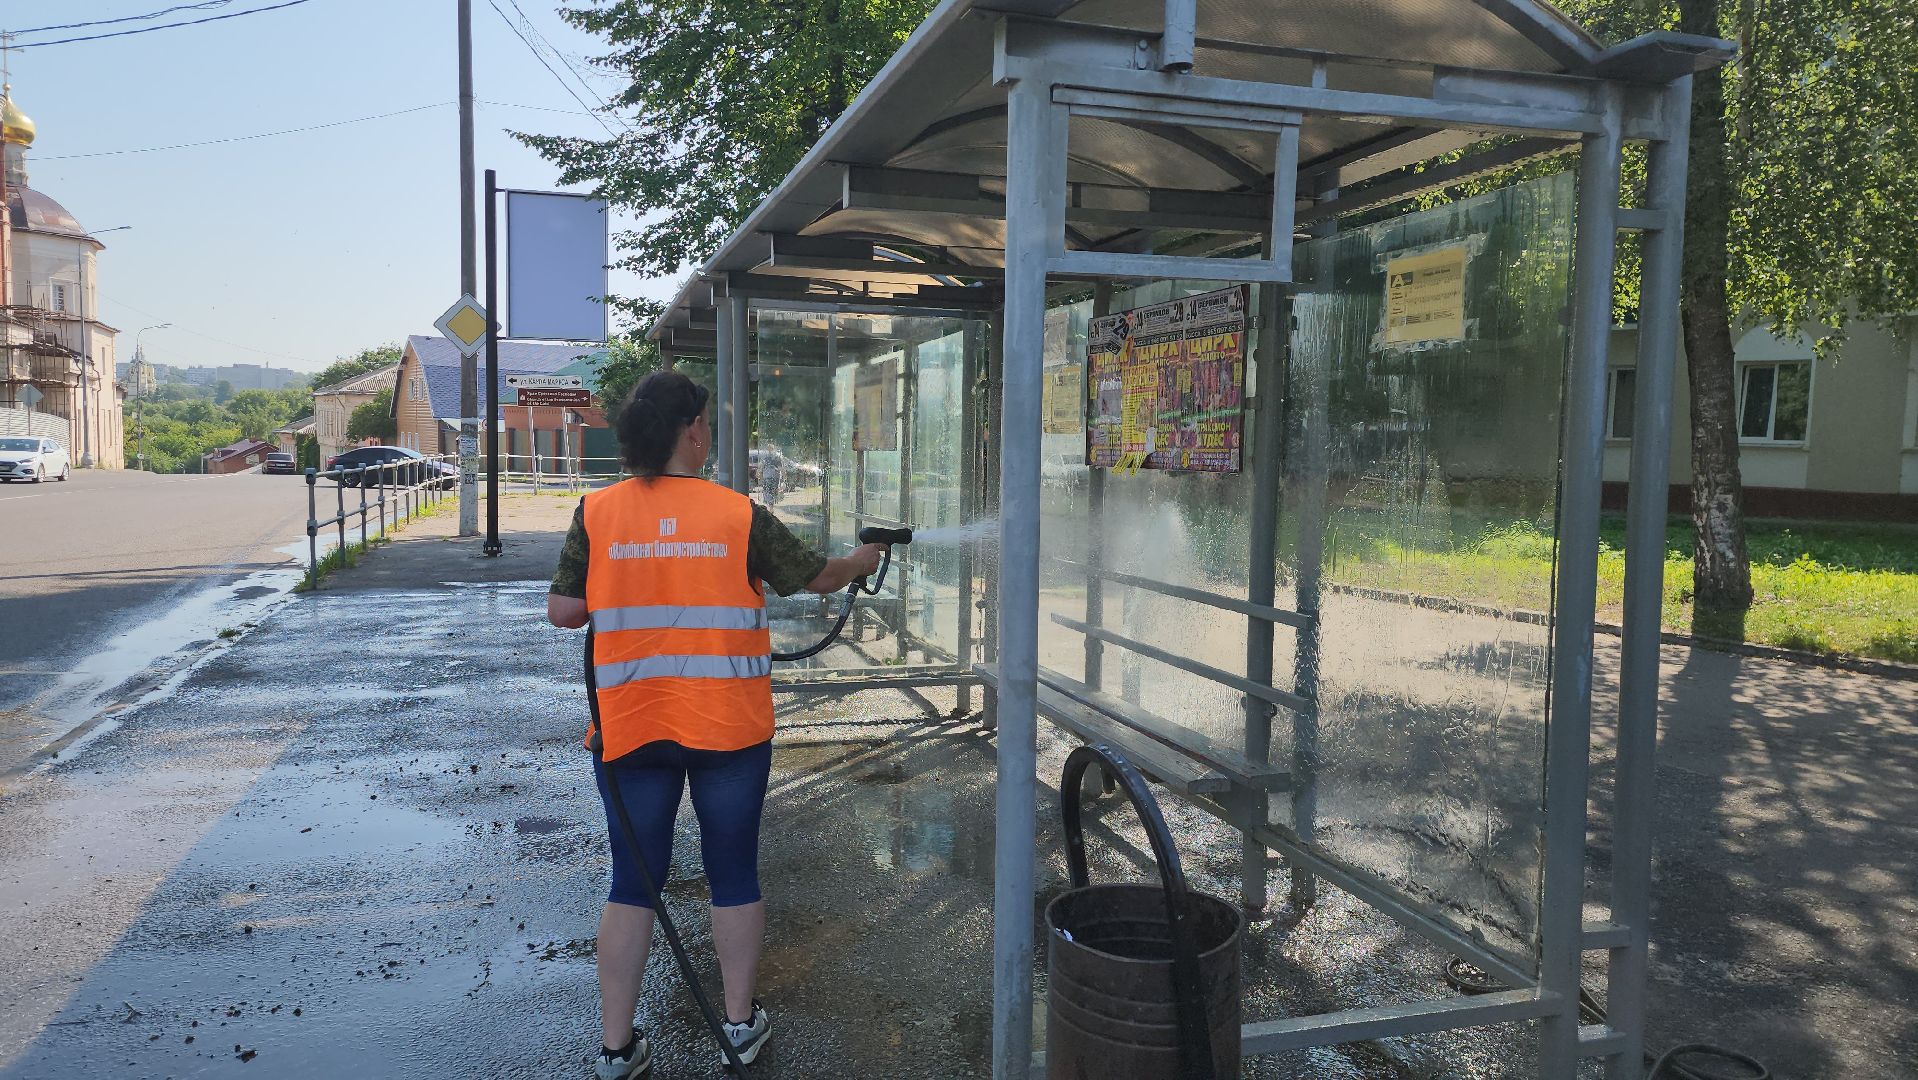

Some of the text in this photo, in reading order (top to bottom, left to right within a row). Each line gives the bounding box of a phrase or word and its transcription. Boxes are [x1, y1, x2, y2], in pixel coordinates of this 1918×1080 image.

[1139, 341, 1179, 362] ЦИРК
[1190, 332, 1236, 357] ЦИРК
[528, 377, 546, 385] КАРЛА
[547, 378, 569, 386] МАРКСА
